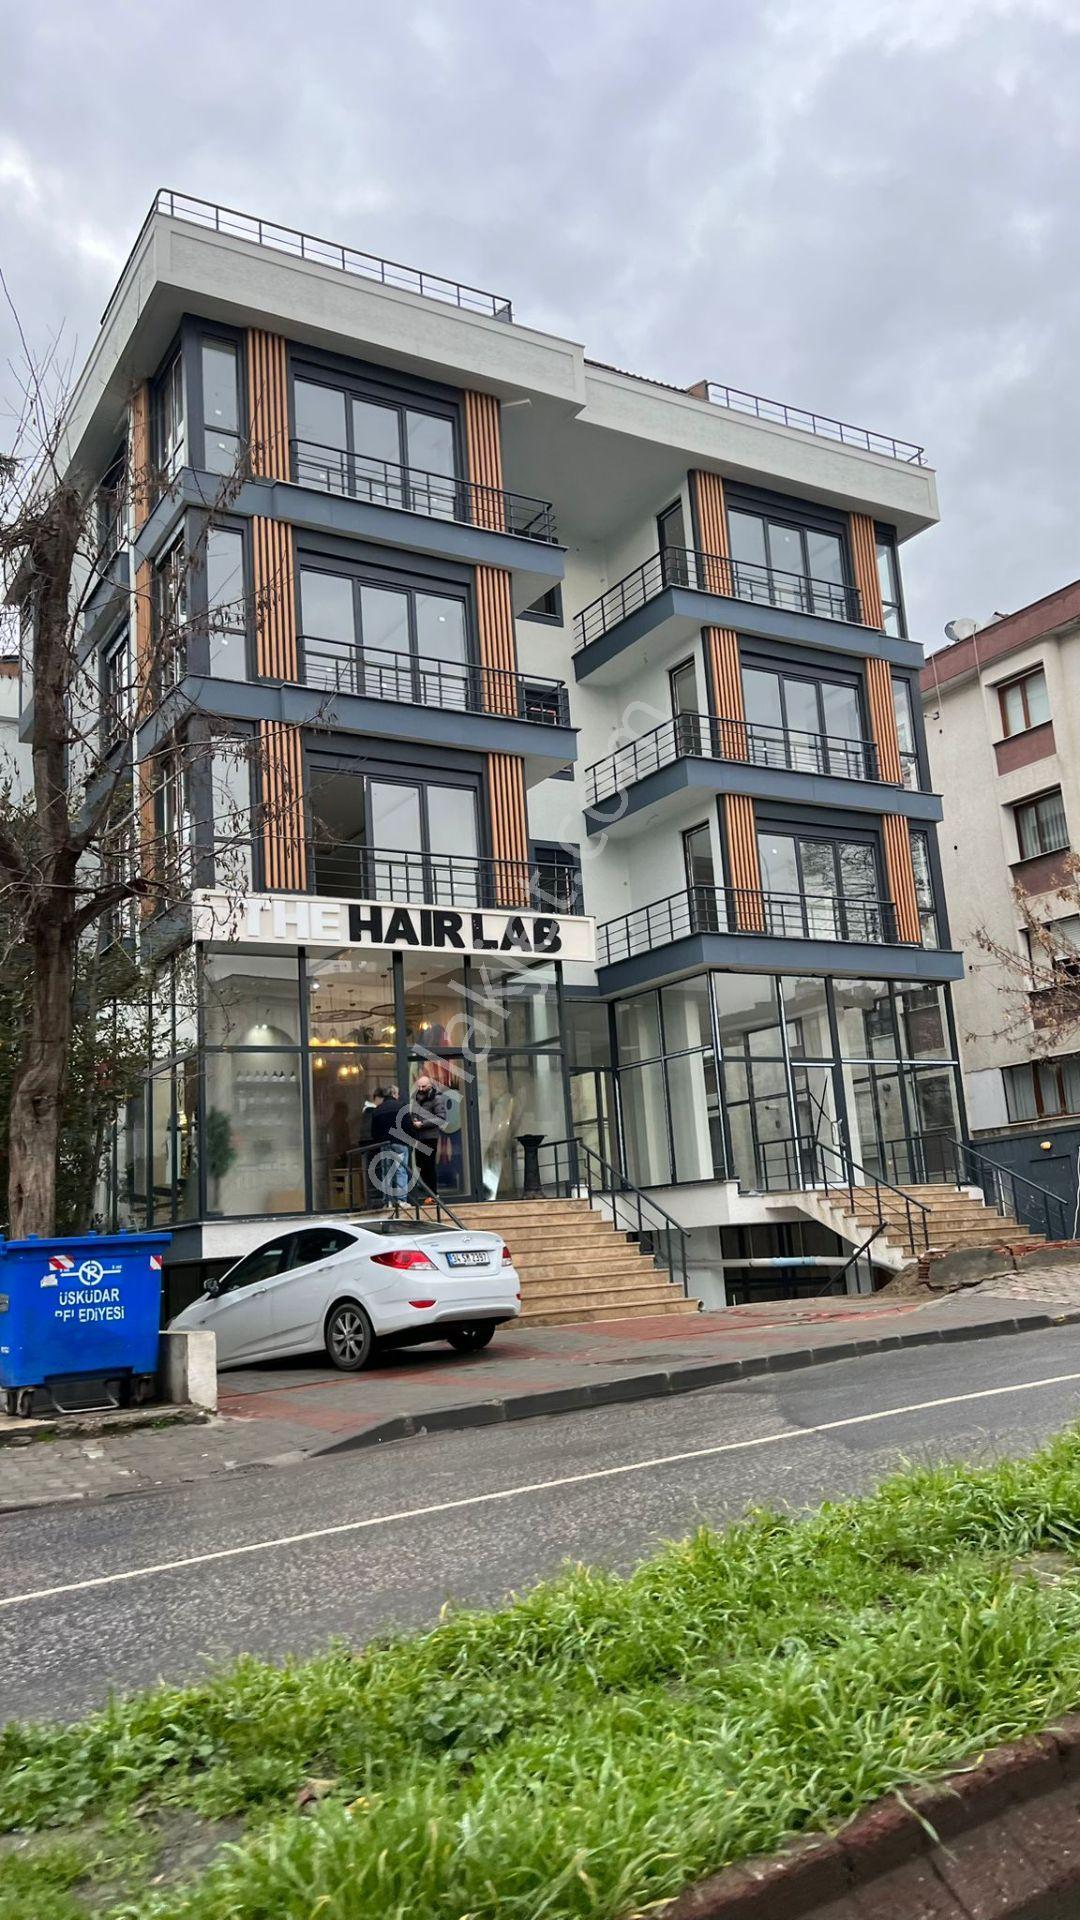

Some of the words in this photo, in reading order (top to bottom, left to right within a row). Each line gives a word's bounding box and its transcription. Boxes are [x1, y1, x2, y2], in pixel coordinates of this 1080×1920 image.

[242, 899, 342, 942] THE
[348, 903, 466, 950] HAIR
[472, 912, 563, 955] LAB
[59, 1288, 120, 1306] ÜSKÜDAR
